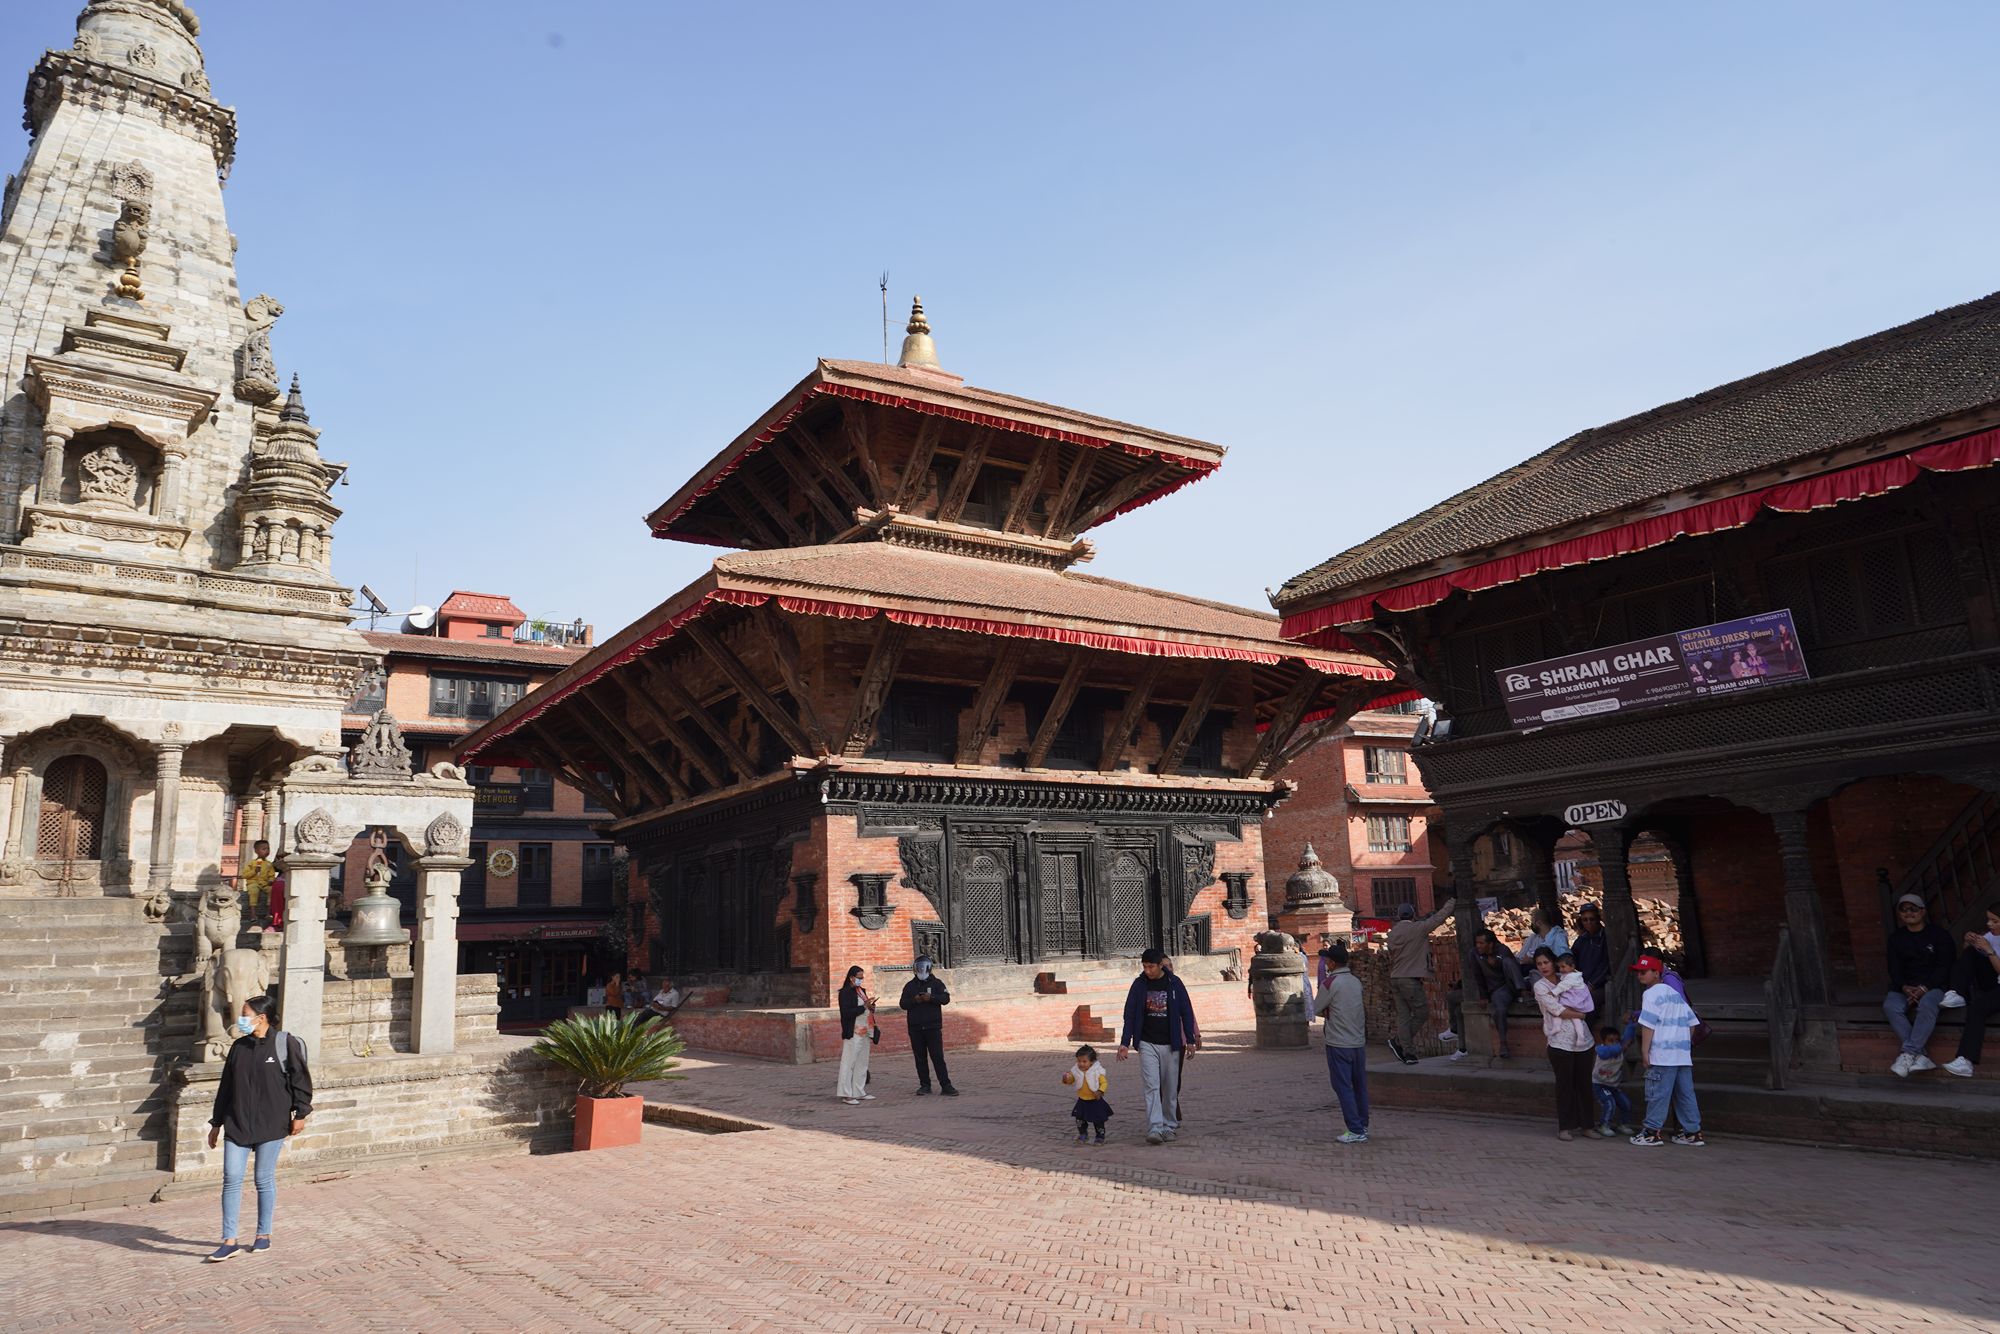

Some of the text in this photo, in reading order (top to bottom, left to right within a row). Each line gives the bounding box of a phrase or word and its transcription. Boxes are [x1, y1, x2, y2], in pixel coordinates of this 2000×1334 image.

[1681, 629, 1711, 641] NEPALI
[1682, 637, 1722, 651] CULTURE
[1722, 631, 1750, 643] DRESS
[1613, 646, 1674, 672] GHAR
[1543, 673, 1637, 697] Relaxation House
[1651, 682, 1689, 694] 9869028713
[1738, 677, 1760, 687] GHAR
[1513, 717, 1526, 725] Entry
[492, 794, 518, 804] HOUSE
[1570, 801, 1621, 822] OPEN
[545, 929, 593, 937] RESTAURANT
